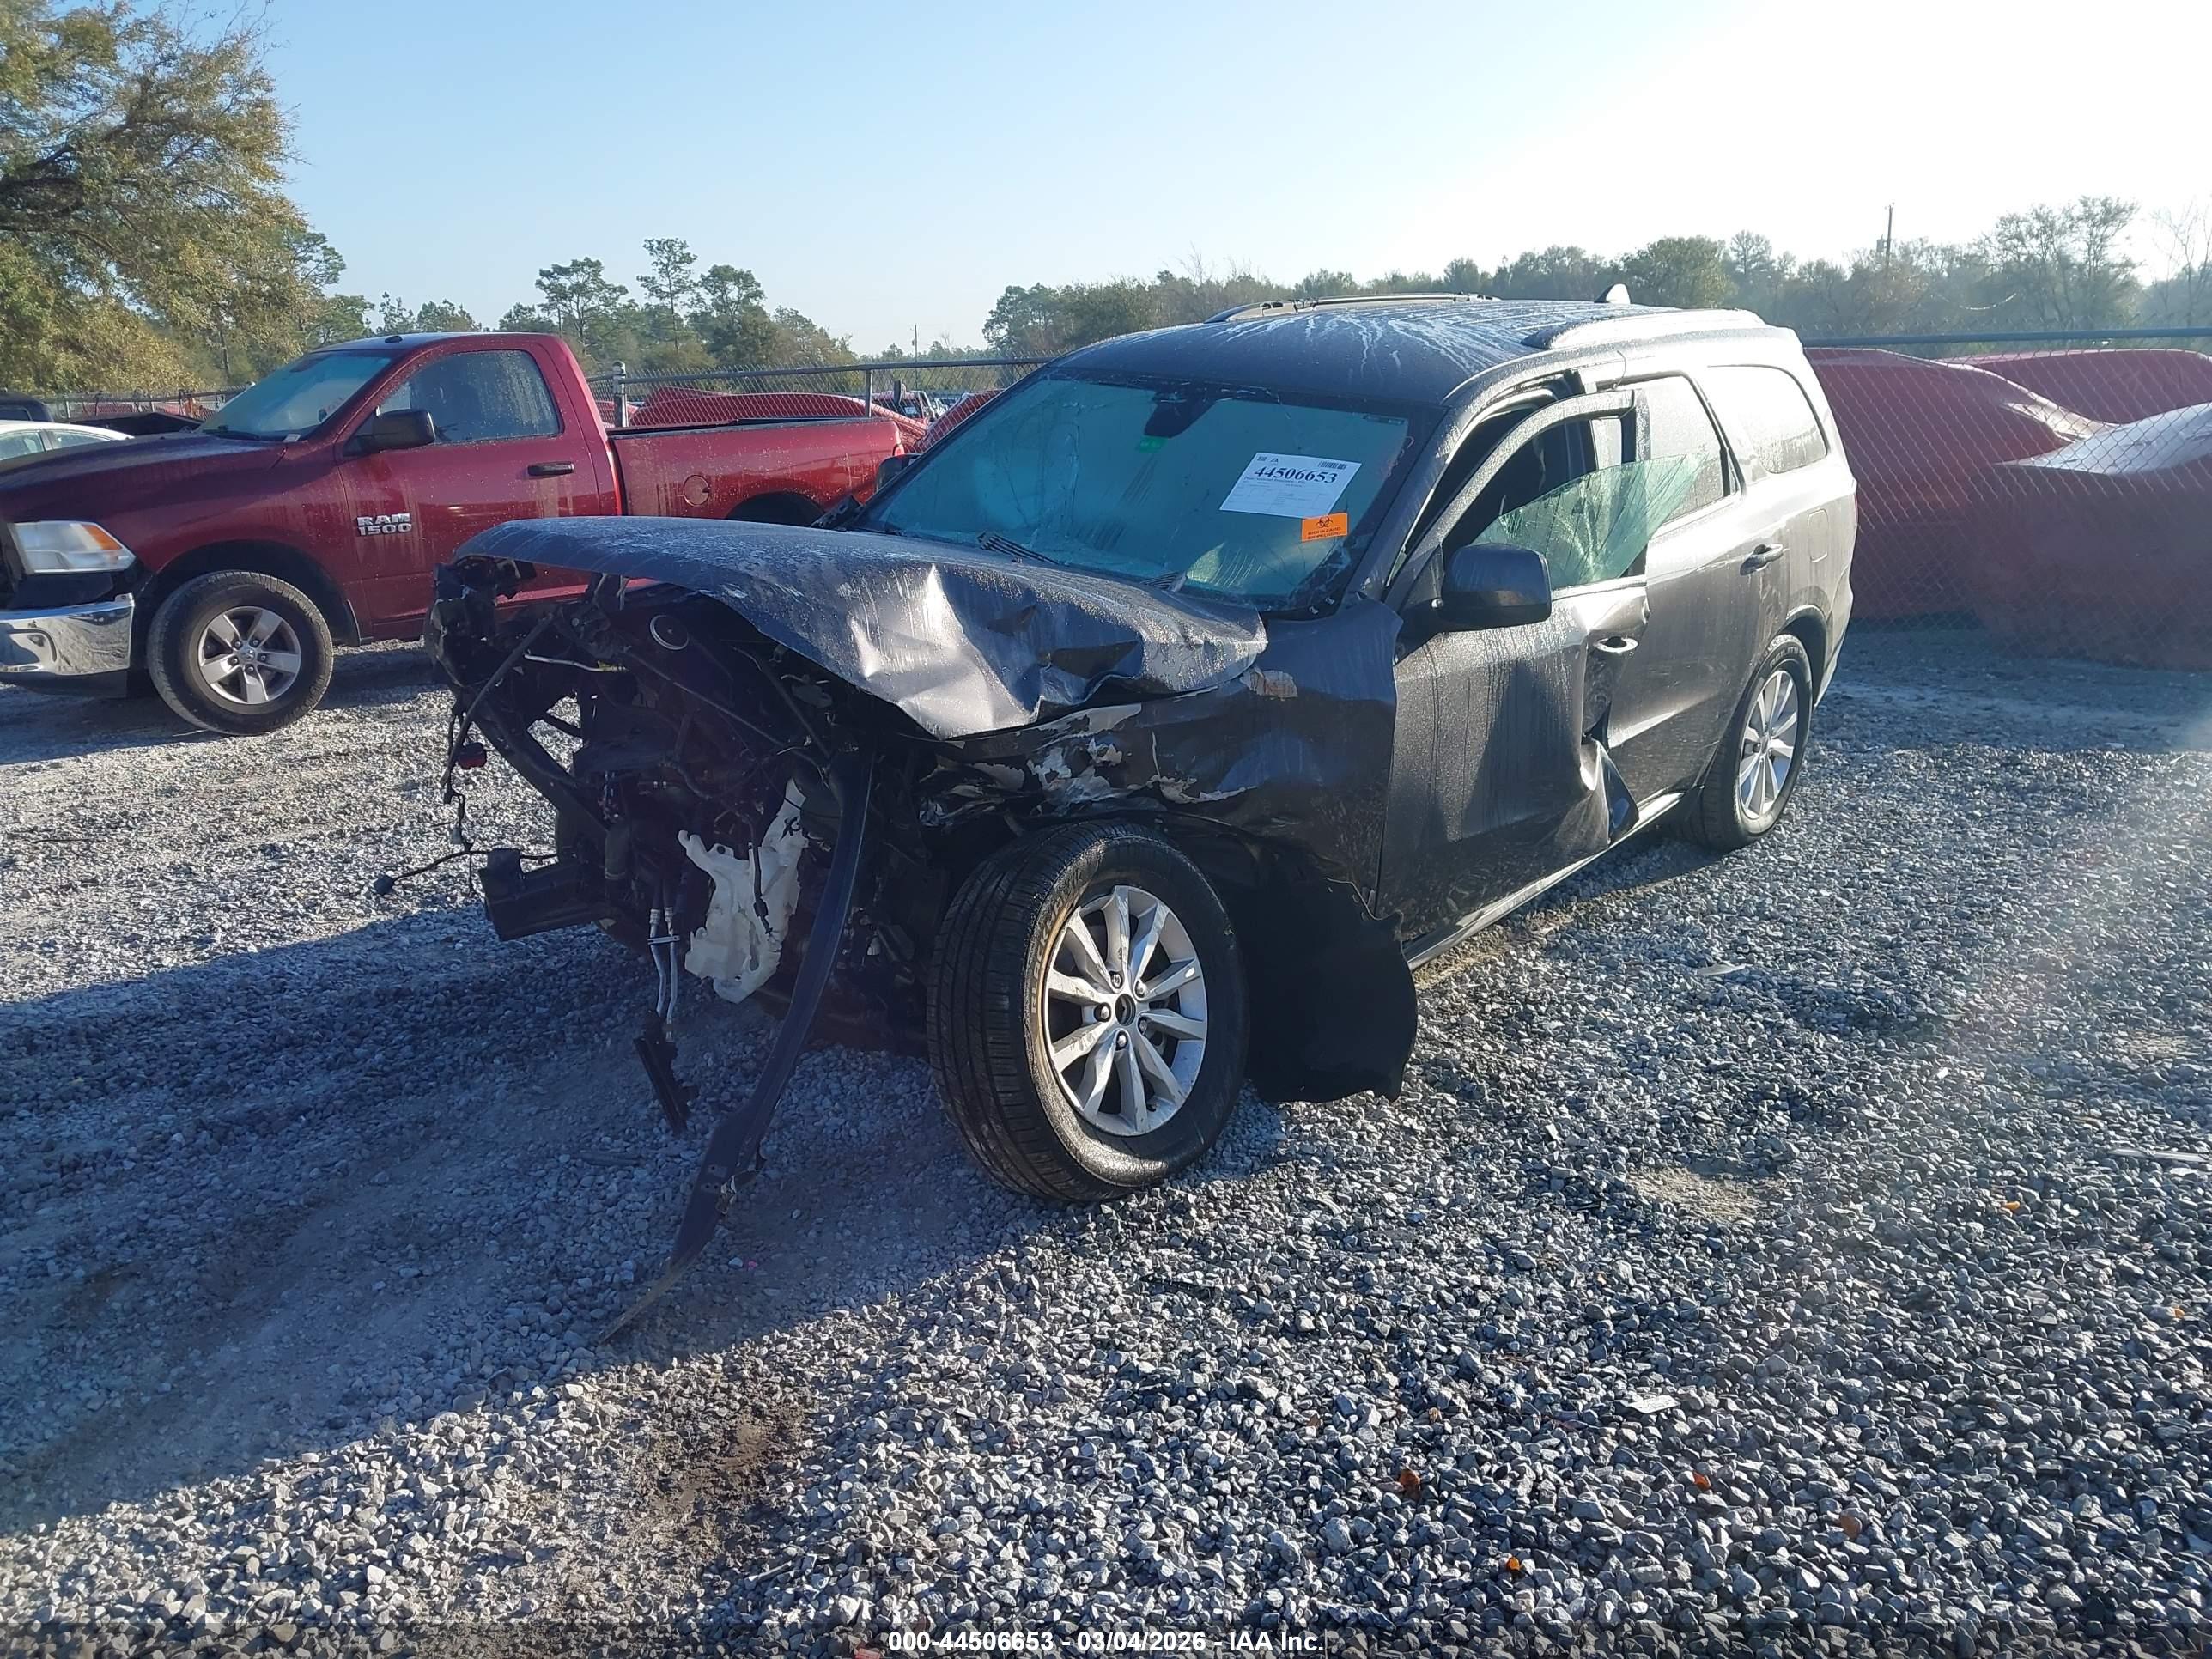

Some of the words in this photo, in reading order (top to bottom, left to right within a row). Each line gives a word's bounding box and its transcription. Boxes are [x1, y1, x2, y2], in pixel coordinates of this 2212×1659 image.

[1254, 466, 1339, 483] 44506653
[357, 513, 410, 526] RAM
[358, 523, 412, 536] 1500
